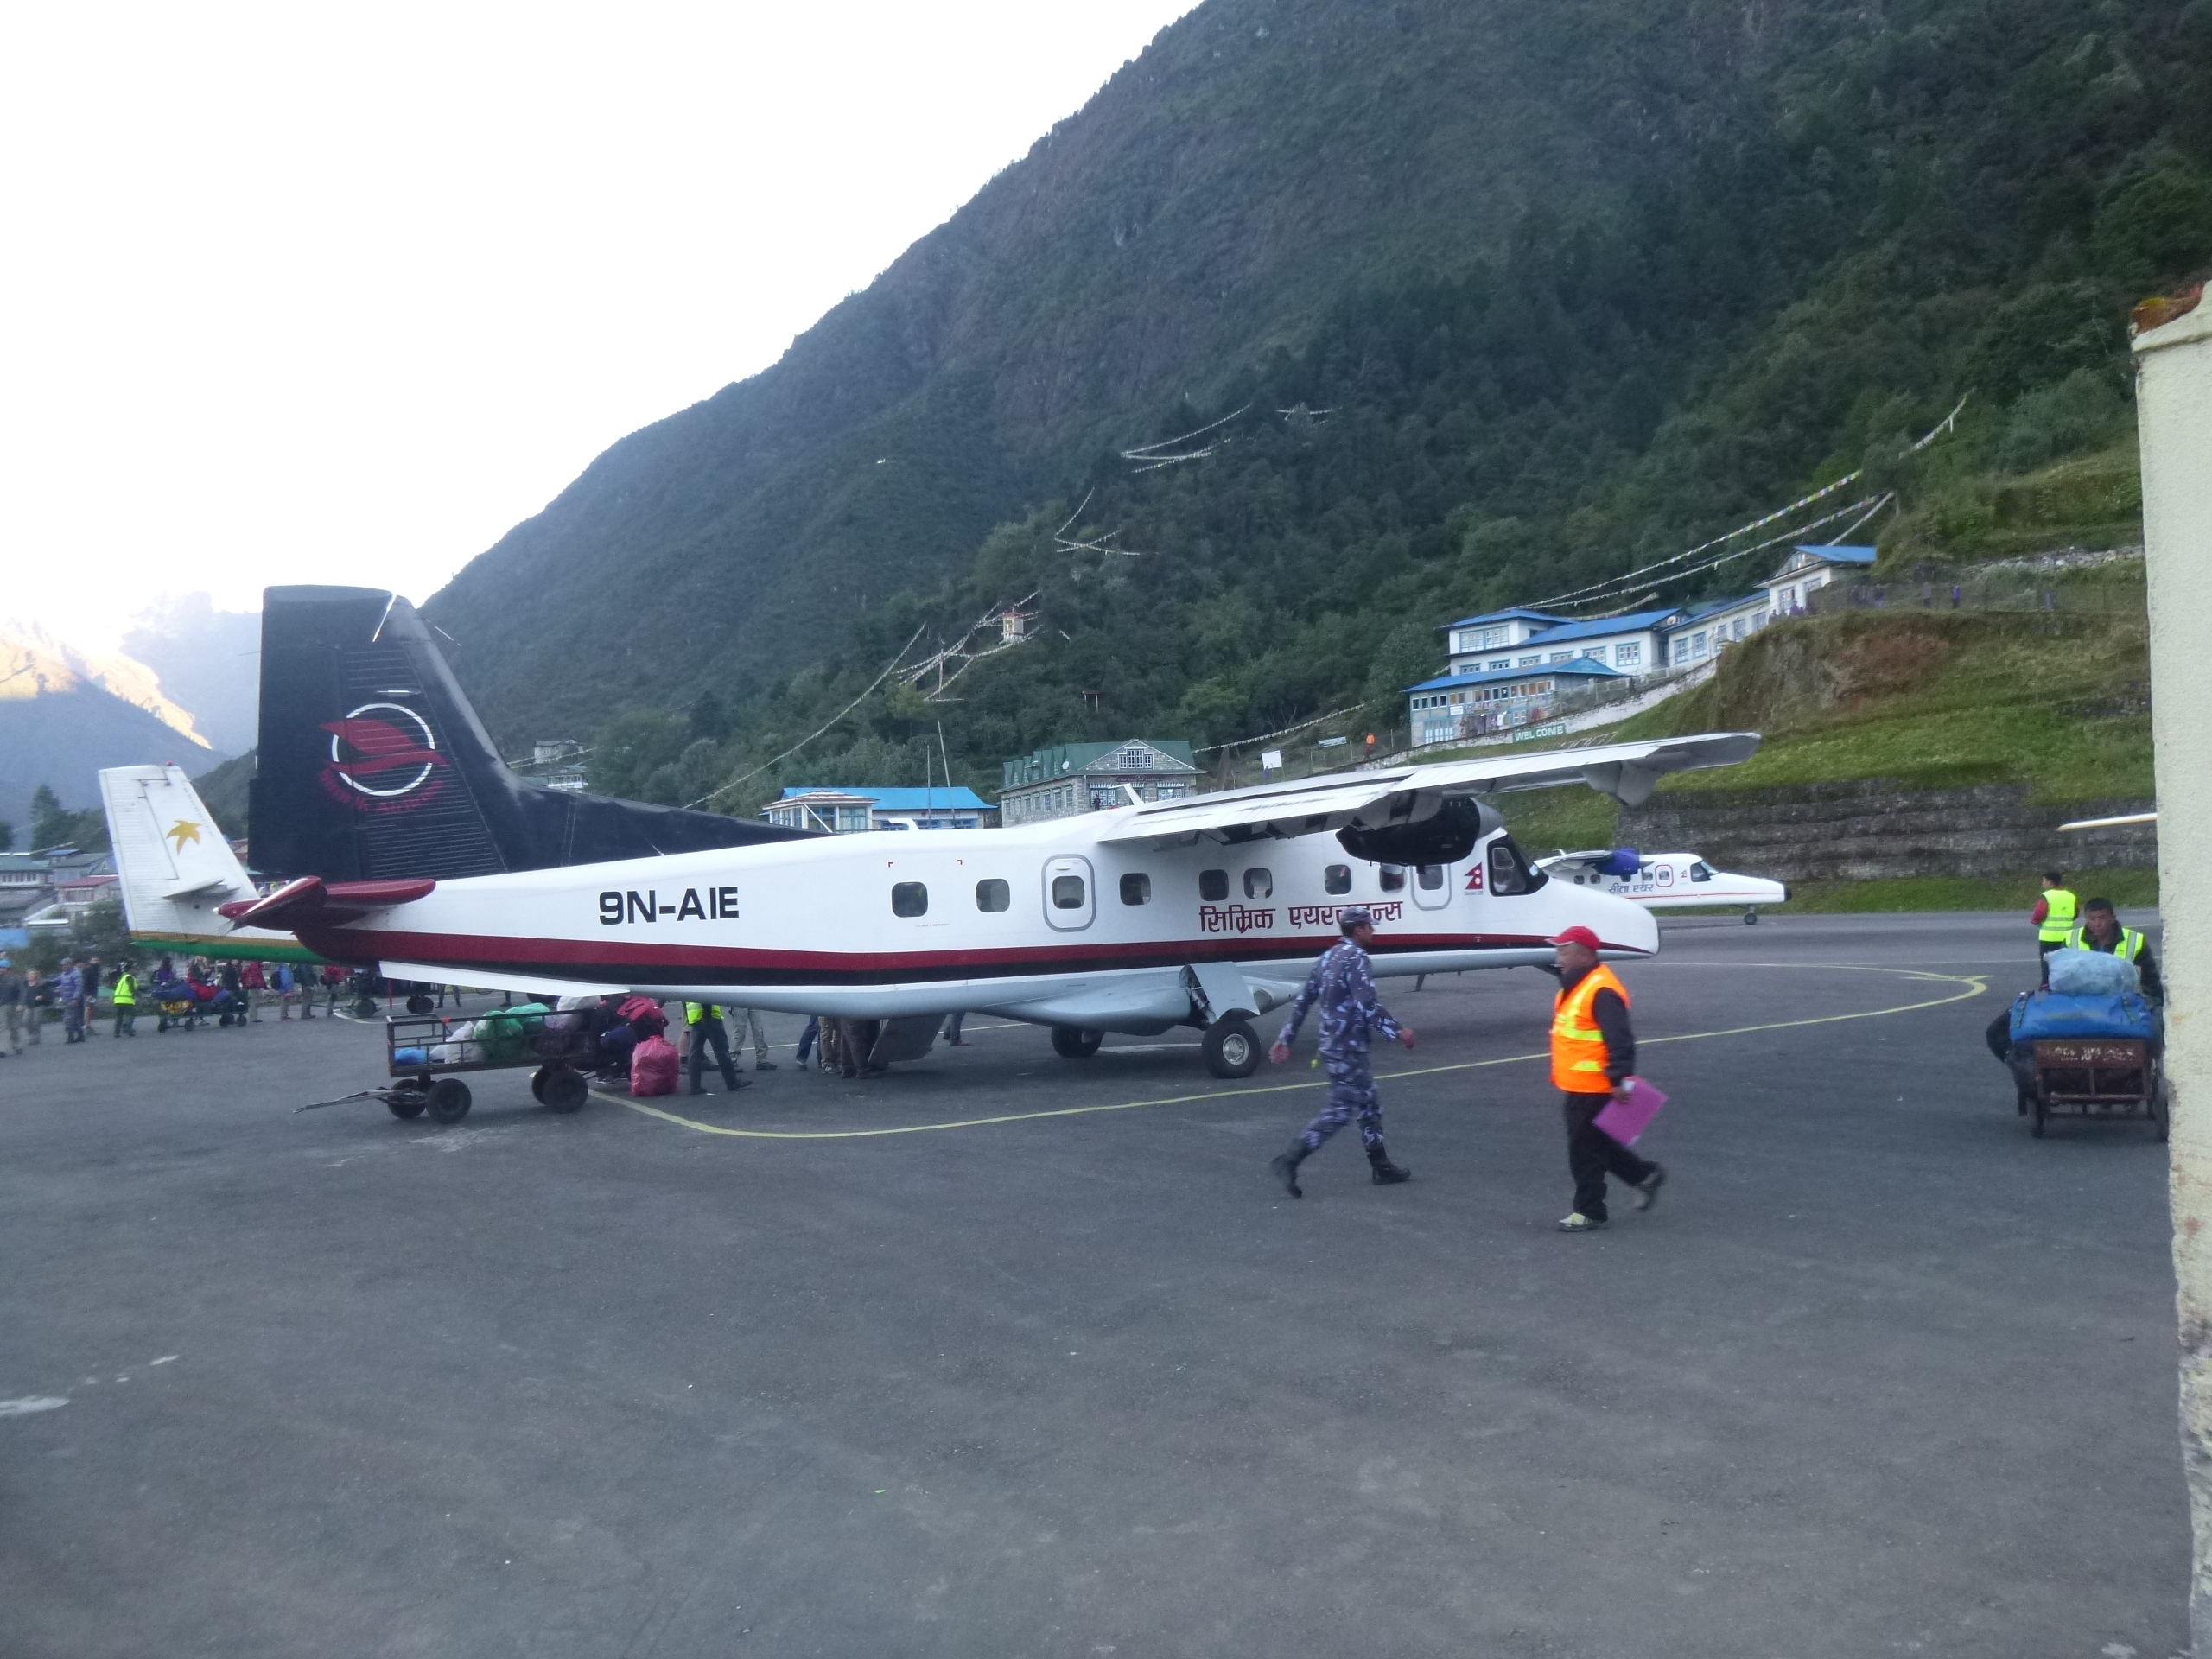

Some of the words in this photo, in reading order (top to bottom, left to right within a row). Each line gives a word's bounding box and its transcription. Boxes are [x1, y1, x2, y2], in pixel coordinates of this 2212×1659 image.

[1608, 882, 1629, 893] सीता
[1632, 883, 1654, 893] एयर
[599, 887, 740, 925] 9N-AIE
[1287, 901, 1403, 929] एयरन्स
